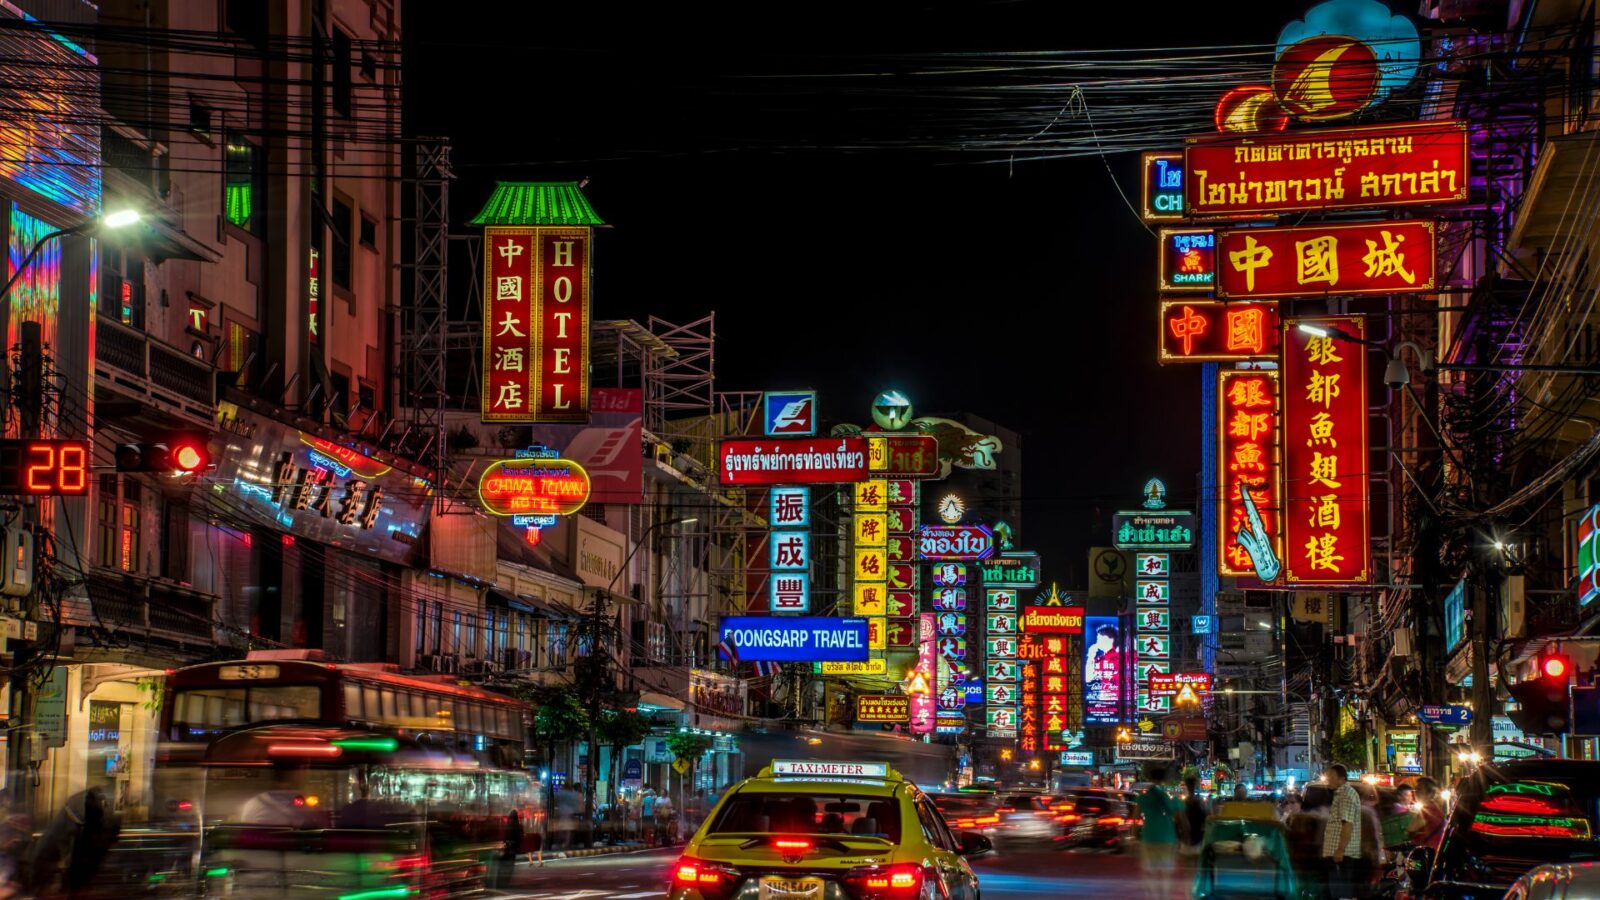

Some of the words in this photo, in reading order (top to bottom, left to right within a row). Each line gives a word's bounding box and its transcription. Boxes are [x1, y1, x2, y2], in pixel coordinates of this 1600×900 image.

[1229, 231, 1415, 292] 中國城
[494, 239, 526, 409] 中國大酒店
[552, 241, 575, 409] HOTEL
[486, 478, 534, 494] CHINA
[725, 440, 864, 480] รุ่งทรัพย์การท่องเที่ยว
[1304, 333, 1345, 573] 銀都魚翅酒樓
[511, 496, 558, 510] HOTEL
[776, 493, 804, 608] 振成豐
[813, 630, 863, 649] TRAVEL
[993, 593, 1009, 728] 和成興大金行
[916, 642, 931, 724] 北京仁堂
[1047, 639, 1064, 749] 聯成興大金
[1460, 710, 1468, 720] 2
[790, 762, 864, 776] TAXI-METER
